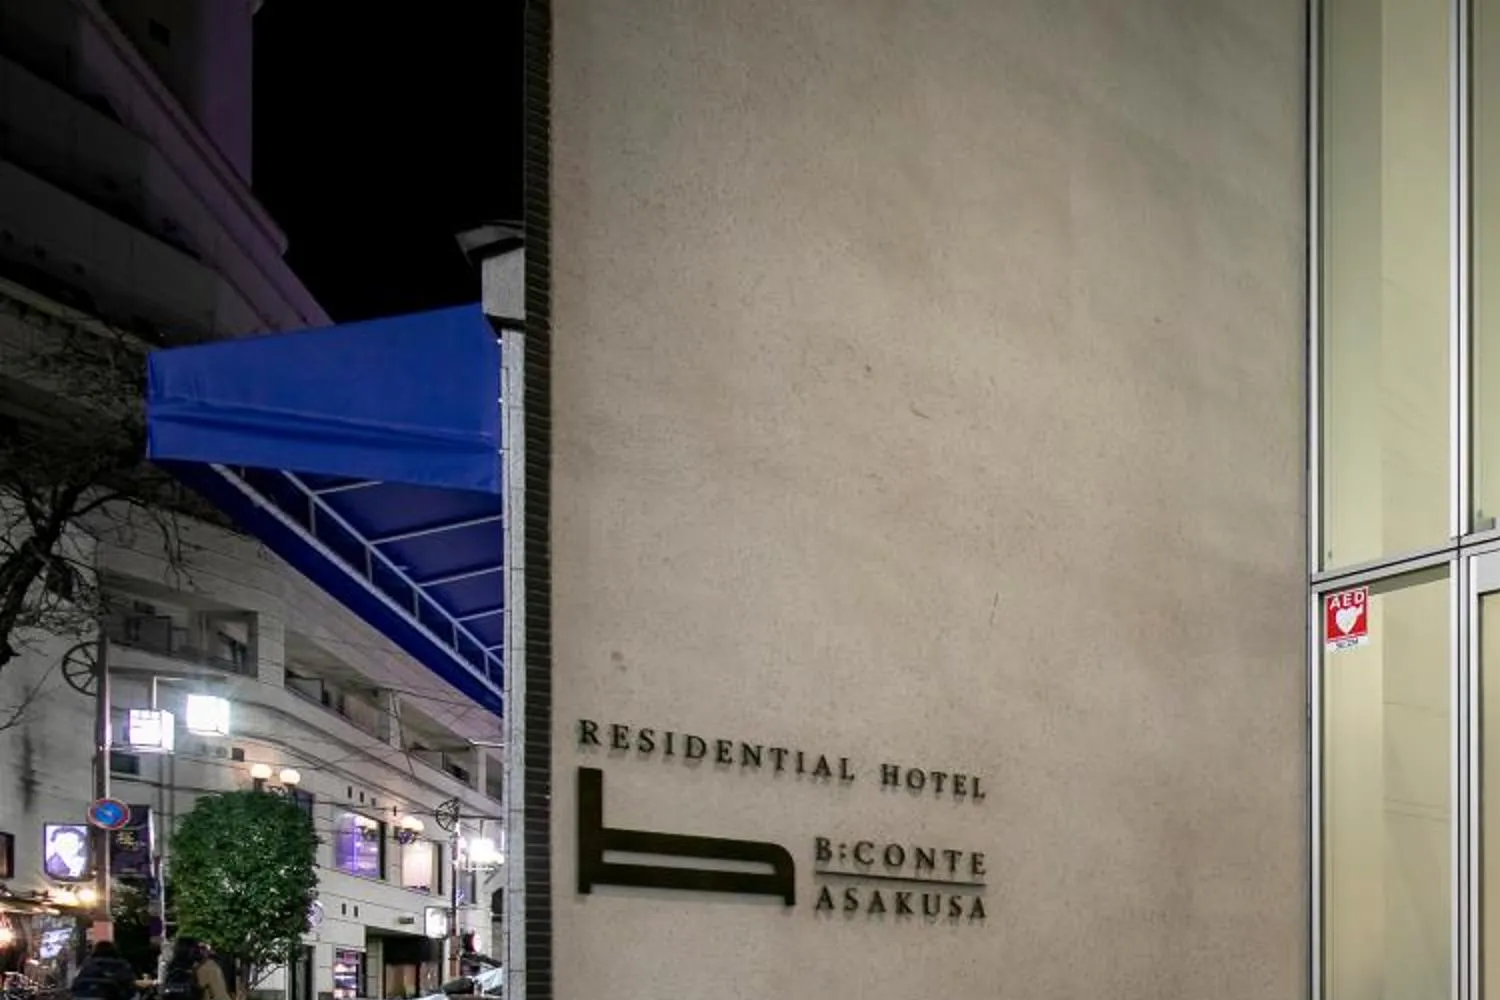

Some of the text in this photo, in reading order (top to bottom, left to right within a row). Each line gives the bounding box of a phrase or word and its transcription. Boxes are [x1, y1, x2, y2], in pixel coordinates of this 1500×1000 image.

[1329, 591, 1365, 610] AED
[578, 719, 986, 799] RESIDENTIAL HOTEL
[814, 886, 987, 920] ASAKUSA
